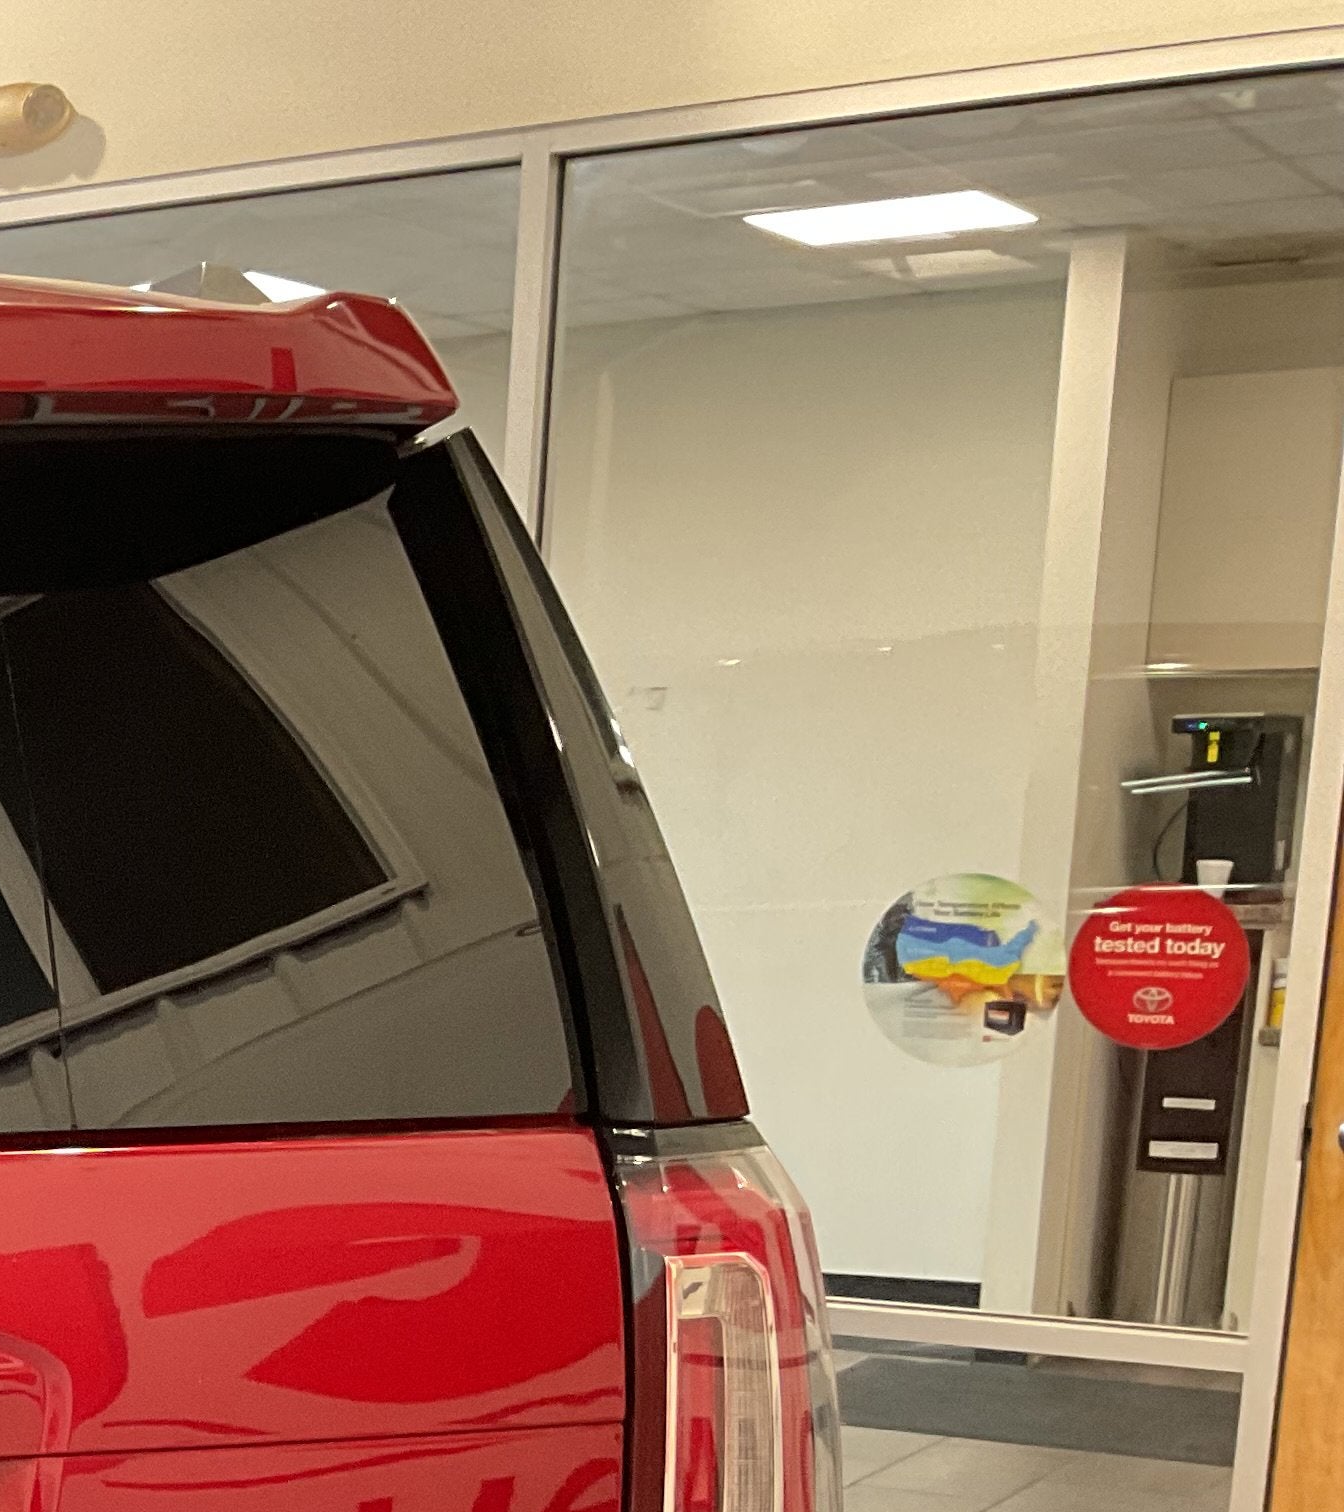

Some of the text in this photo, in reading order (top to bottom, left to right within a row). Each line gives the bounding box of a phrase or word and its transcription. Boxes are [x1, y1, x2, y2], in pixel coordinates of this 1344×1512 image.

[1108, 920, 1214, 937] Get your battery
[1094, 935, 1226, 959] tested today
[1127, 1013, 1175, 1025] TOYOTA
